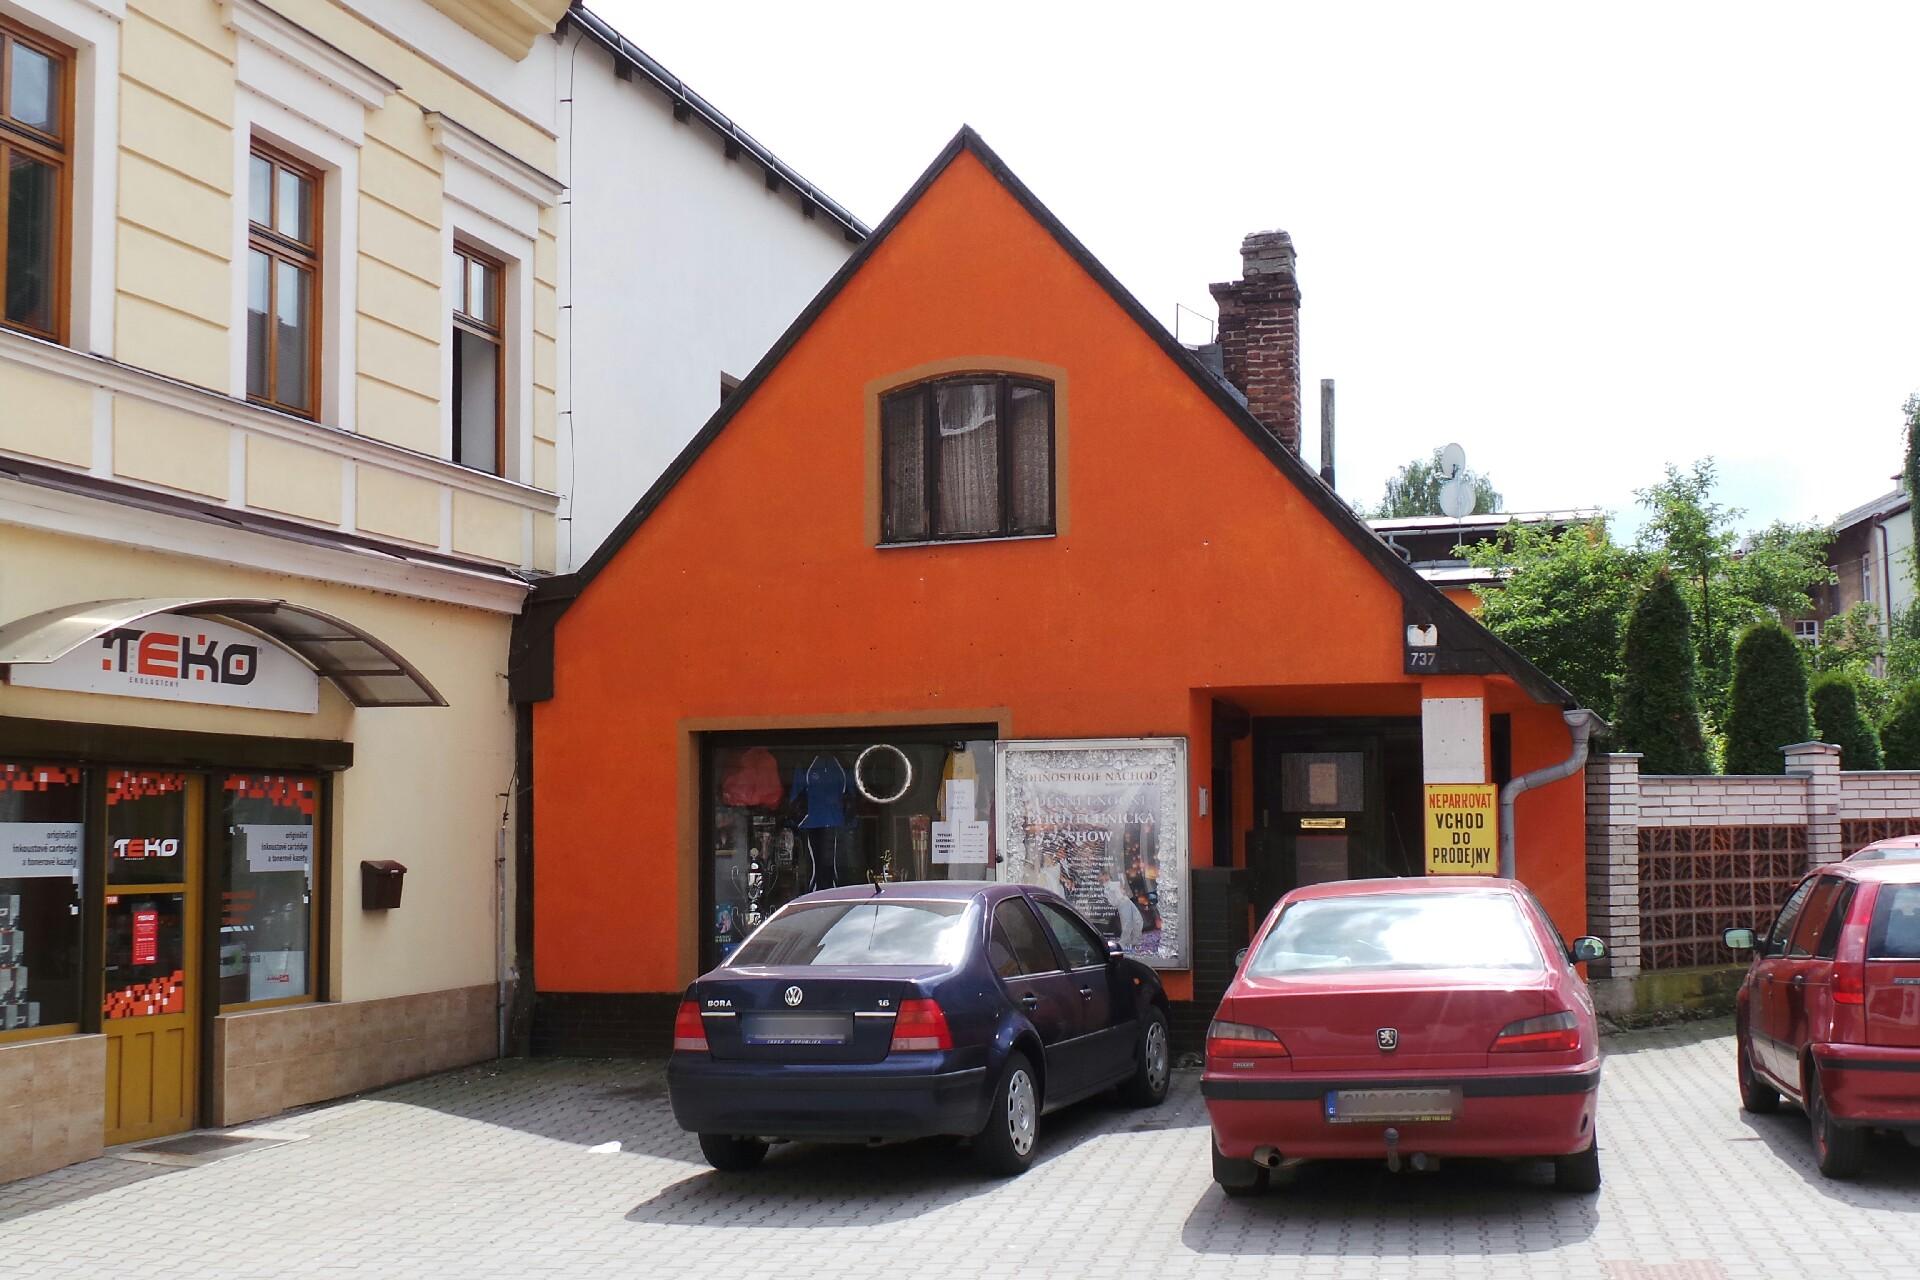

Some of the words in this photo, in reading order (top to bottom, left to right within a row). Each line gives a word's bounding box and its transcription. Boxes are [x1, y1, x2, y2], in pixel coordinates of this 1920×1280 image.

[97, 628, 258, 686] TEKO
[1410, 653, 1435, 666] 737
[1429, 793, 1492, 808] NEPARKOVAT
[1435, 813, 1484, 829] VCHOD
[1068, 831, 1113, 842] SHOW
[1452, 832, 1471, 845] DO
[112, 837, 178, 858] TEKO
[1433, 847, 1490, 868] PRODEJNY
